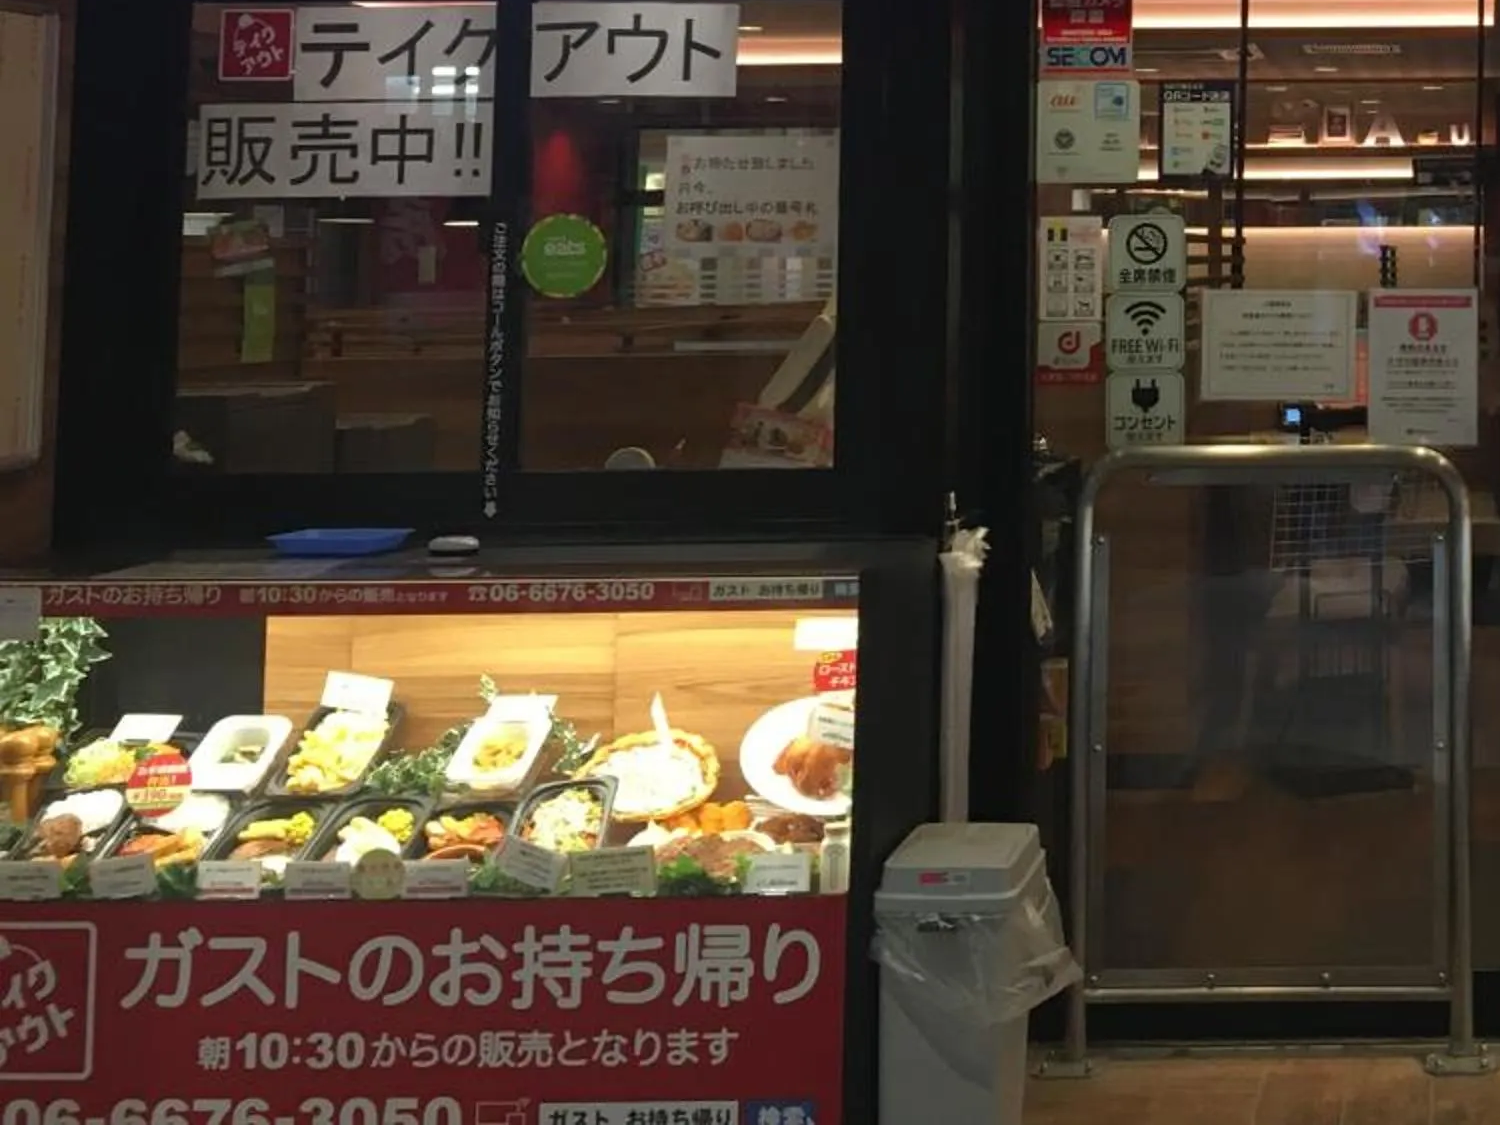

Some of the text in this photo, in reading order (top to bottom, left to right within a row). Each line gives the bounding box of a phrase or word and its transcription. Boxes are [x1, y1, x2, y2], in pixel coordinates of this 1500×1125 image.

[300, 14, 722, 88] テイク アウト
[1046, 46, 1127, 67] SECOM
[1119, 267, 1177, 284] 全席禁煙
[1111, 338, 1149, 354] FREE
[1113, 416, 1177, 431] コンセント
[46, 586, 222, 606] ガストのお持ち帰り
[120, 922, 821, 1010] ガストのお持ち帰り
[196, 1027, 739, 1071] 朝10:30からの販売となります
